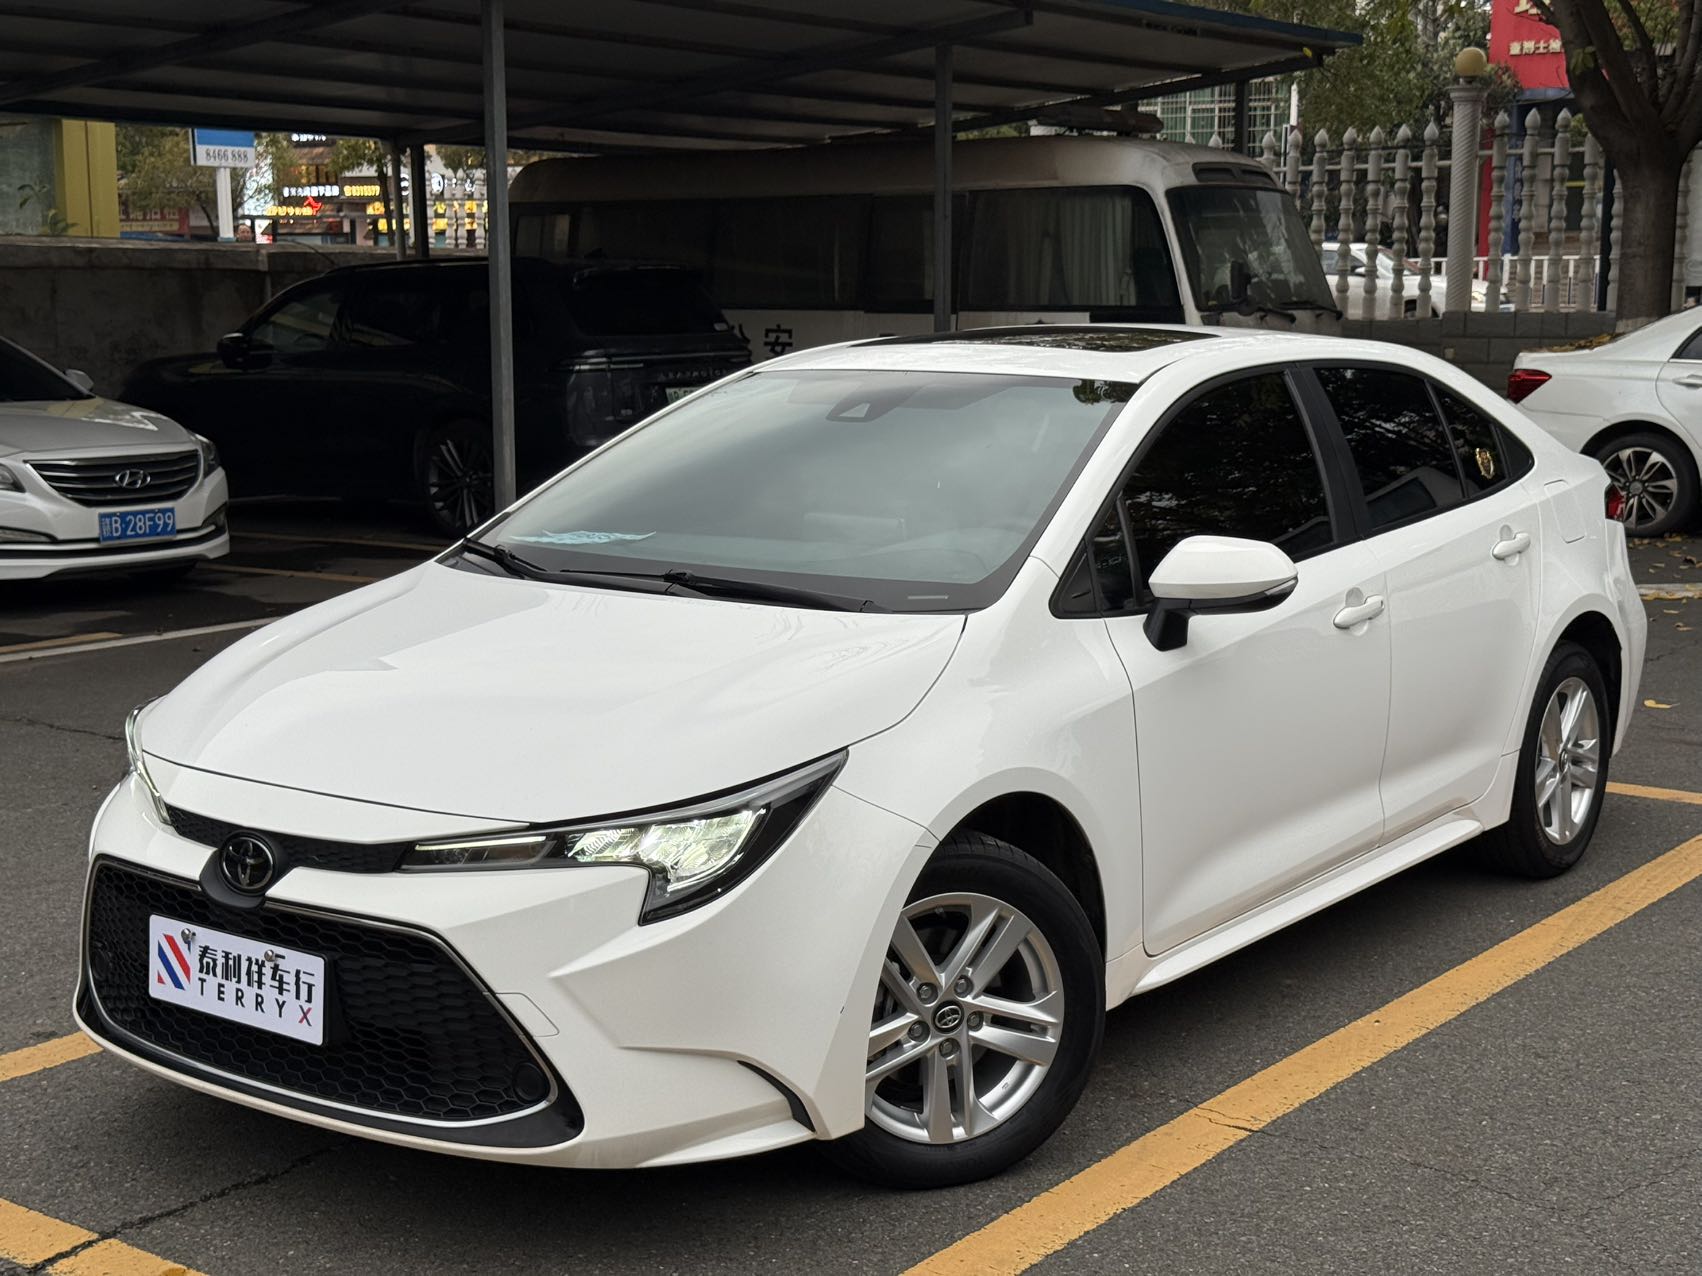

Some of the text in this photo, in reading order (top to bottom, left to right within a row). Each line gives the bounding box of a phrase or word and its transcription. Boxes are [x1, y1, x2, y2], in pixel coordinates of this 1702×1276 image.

[205, 148, 249, 163] 8466 888
[198, 944, 316, 1004] 泰利祥车行
